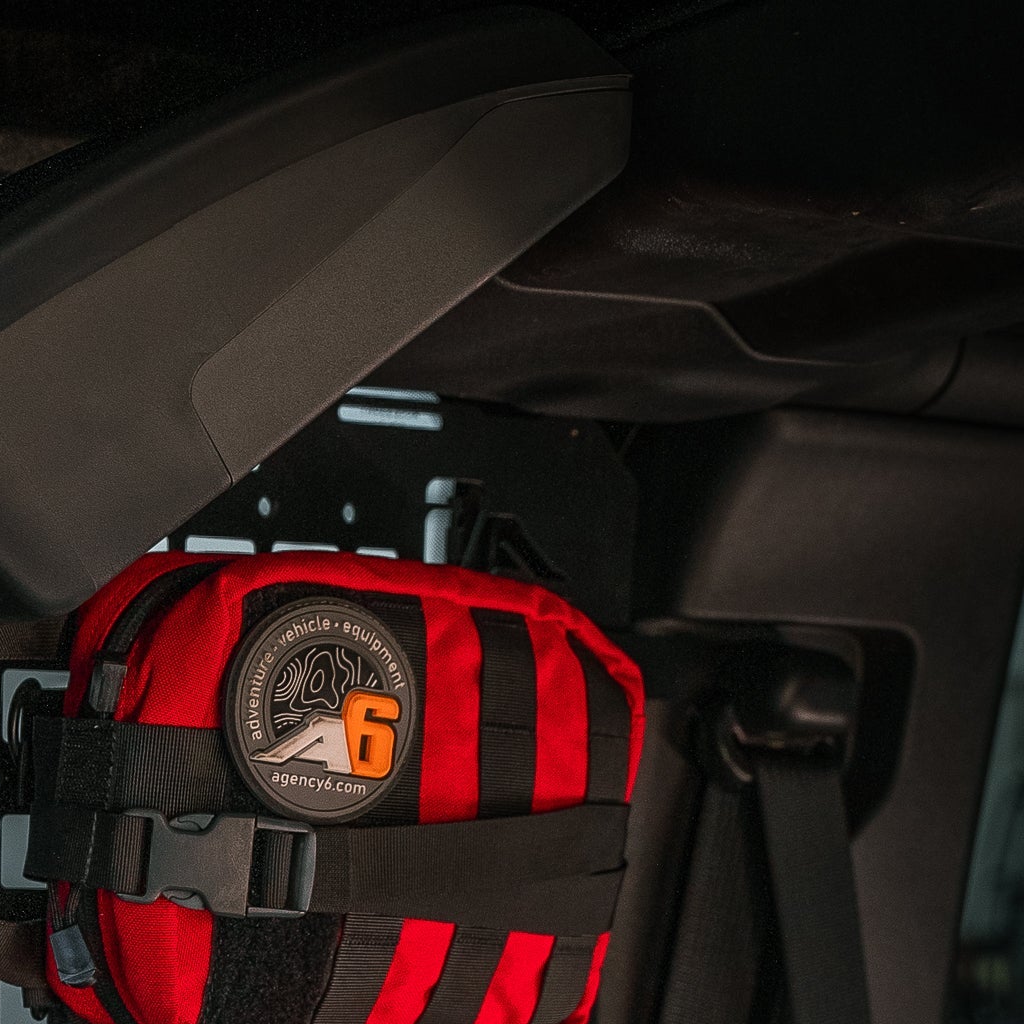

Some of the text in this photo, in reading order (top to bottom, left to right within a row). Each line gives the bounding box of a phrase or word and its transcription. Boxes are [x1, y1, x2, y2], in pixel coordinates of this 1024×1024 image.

[245, 616, 407, 740] adventure vehicle equipment
[271, 771, 367, 795] agency6.com
